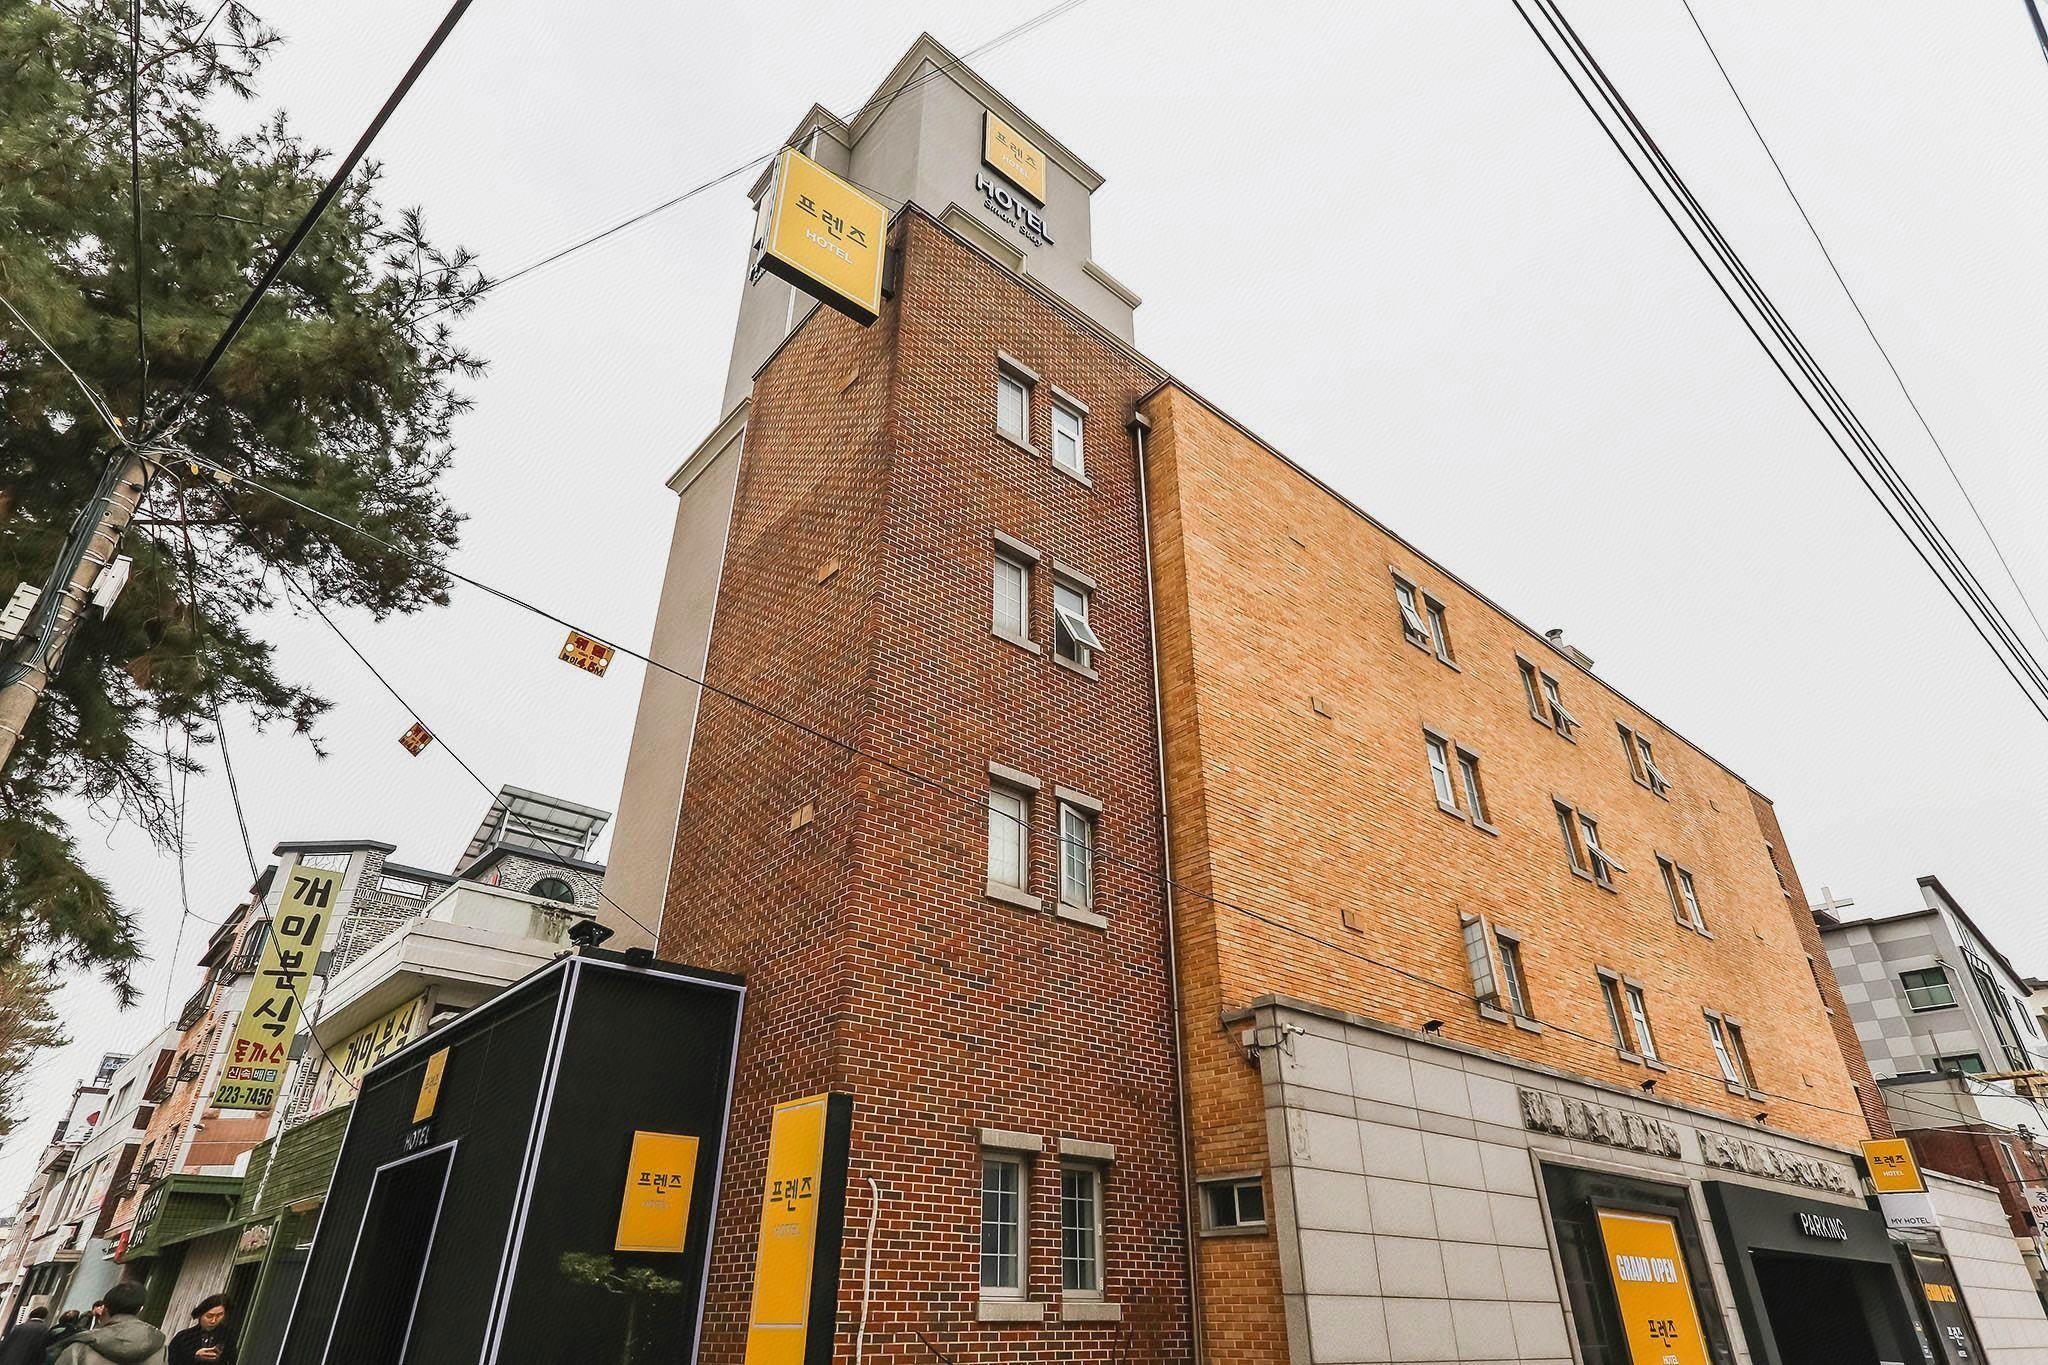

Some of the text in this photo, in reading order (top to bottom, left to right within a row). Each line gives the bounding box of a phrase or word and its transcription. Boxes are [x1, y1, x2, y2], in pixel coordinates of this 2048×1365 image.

[995, 131, 1037, 169] 프렌즈
[795, 194, 867, 248] 프렌즈
[976, 172, 1055, 246] HOTEL
[805, 228, 854, 265] HOTEL
[252, 876, 333, 1037] 개미분식
[234, 1038, 285, 1064] 돈까스
[226, 1066, 278, 1082] 신속배달
[216, 1085, 274, 1106] 223-7456
[1873, 1154, 1906, 1168] 프렌즈
[1882, 1169, 1905, 1177] HOTEL
[637, 1171, 683, 1194] 프렌즈
[770, 1176, 813, 1212] 프렌즈
[1799, 1212, 1848, 1241] PARKING
[1891, 1216, 1931, 1226] MY HOTEL
[1616, 1254, 1678, 1283] GRAND OPEN
[1647, 1319, 1679, 1348] 프렌즈
